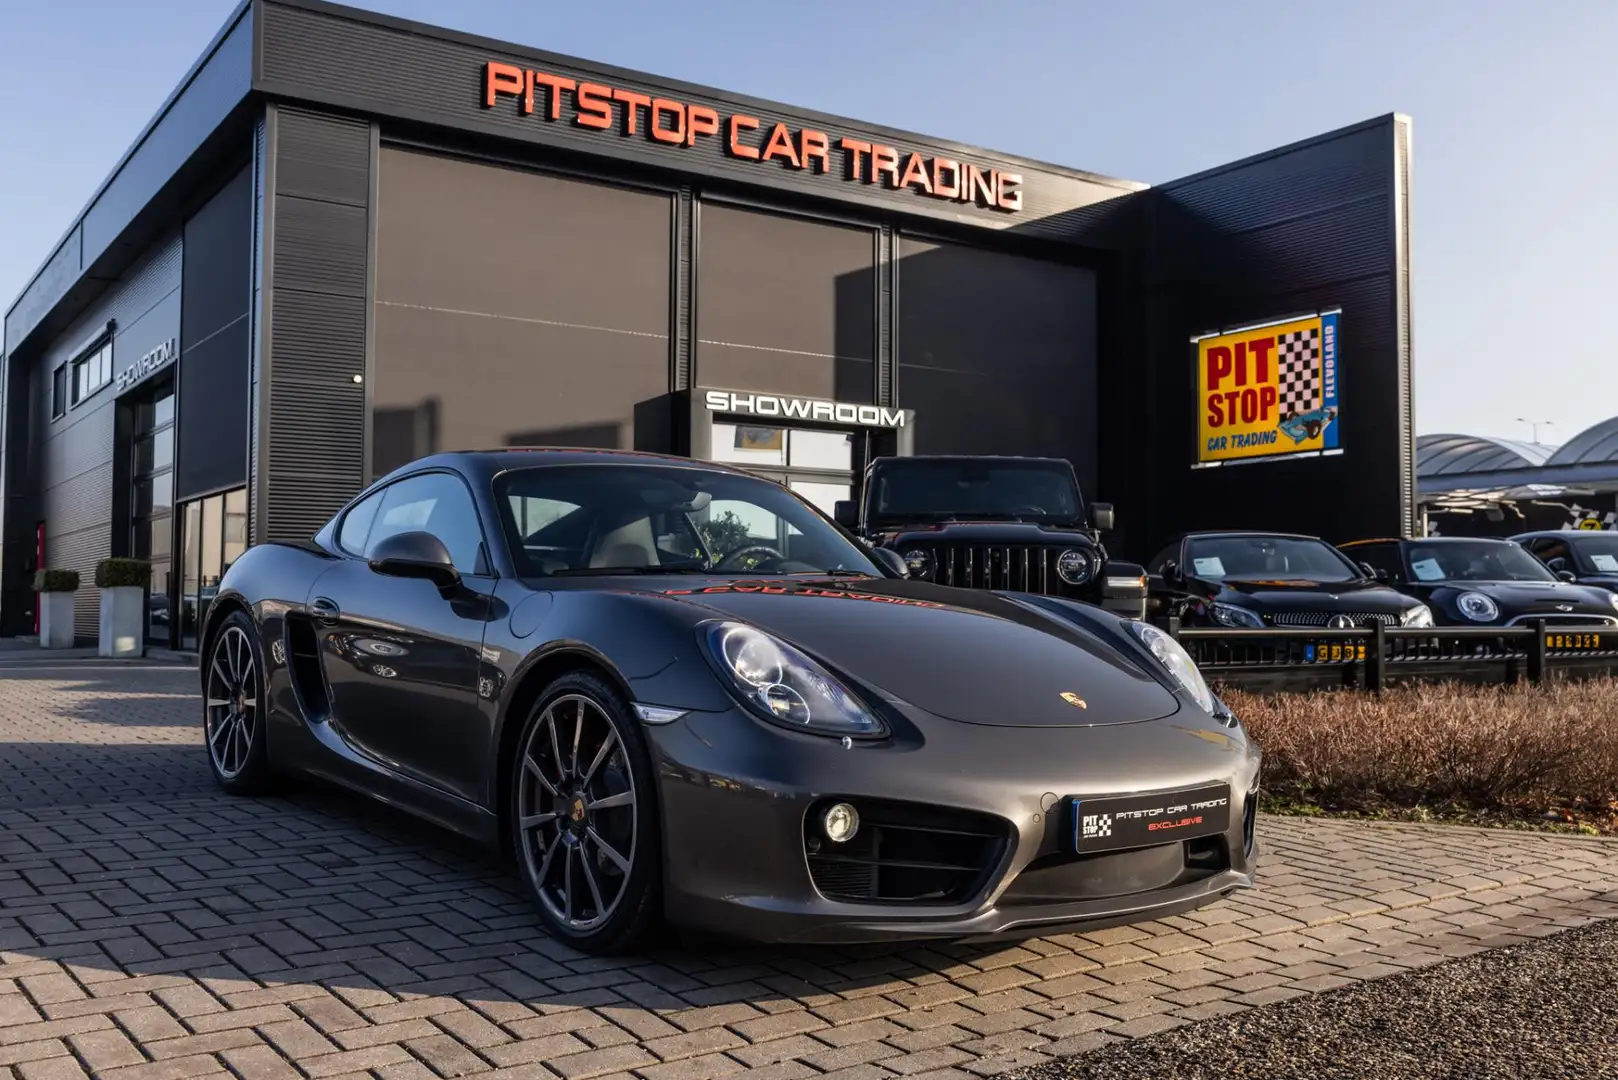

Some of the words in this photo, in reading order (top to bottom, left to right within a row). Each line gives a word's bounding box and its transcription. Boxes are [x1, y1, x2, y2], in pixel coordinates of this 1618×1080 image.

[486, 61, 719, 146] PITSTOP
[730, 113, 829, 174] CAR
[841, 137, 1023, 211] TRADING
[1207, 336, 1275, 391] PIT
[1324, 325, 1335, 398] FLEVOLAND
[705, 391, 905, 427] SHOWROOM
[1207, 386, 1277, 428] STOP
[1207, 433, 1227, 451] CAR
[1231, 430, 1278, 449] TRADING
[1083, 815, 1098, 827] PIT
[1116, 808, 1164, 820] PITSTOP
[1167, 804, 1188, 815] CAR
[1191, 798, 1227, 810] TRADING
[1148, 816, 1203, 831] EXCLUSIVE
[1082, 825, 1098, 835] STOP
